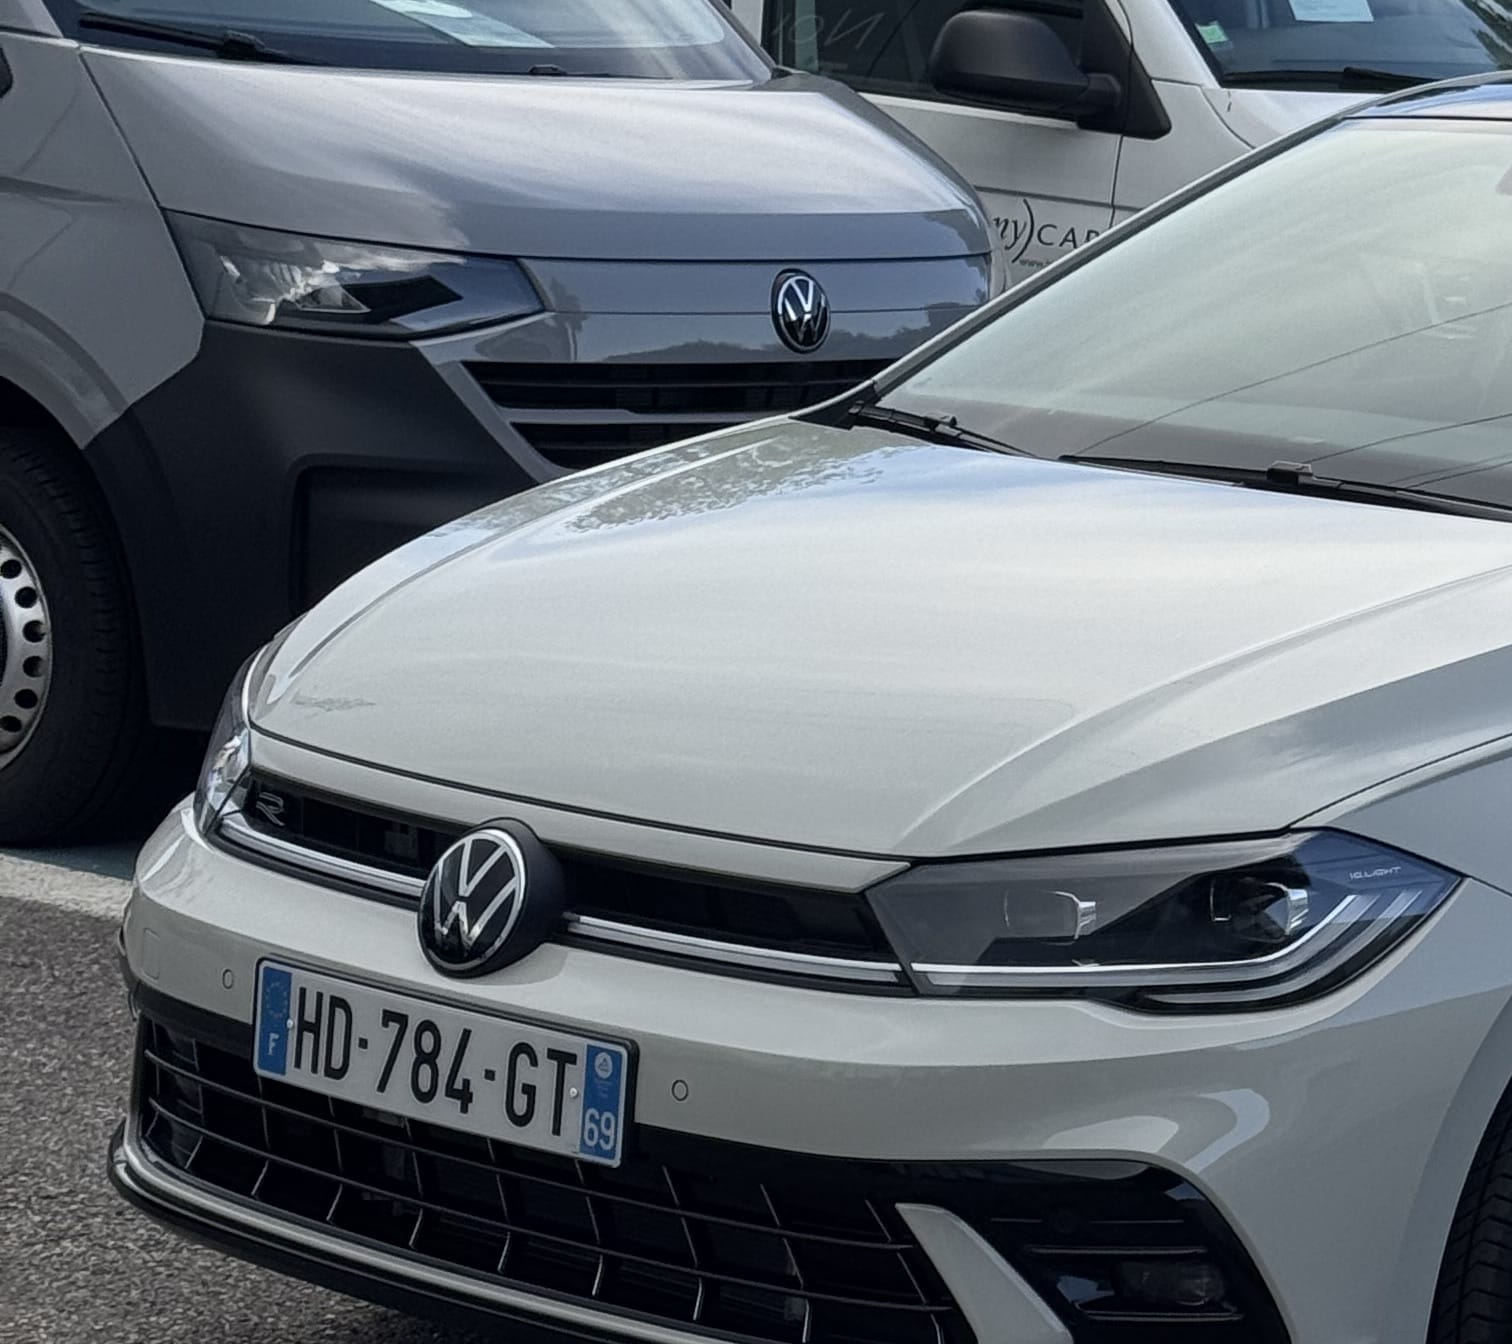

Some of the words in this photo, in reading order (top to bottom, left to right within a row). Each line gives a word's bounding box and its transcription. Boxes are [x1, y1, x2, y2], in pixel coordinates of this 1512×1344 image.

[255, 791, 285, 827] R
[430, 833, 523, 958] VW
[267, 1031, 280, 1057] F
[294, 986, 578, 1137] HD-784-GT
[583, 1107, 616, 1151] 69
